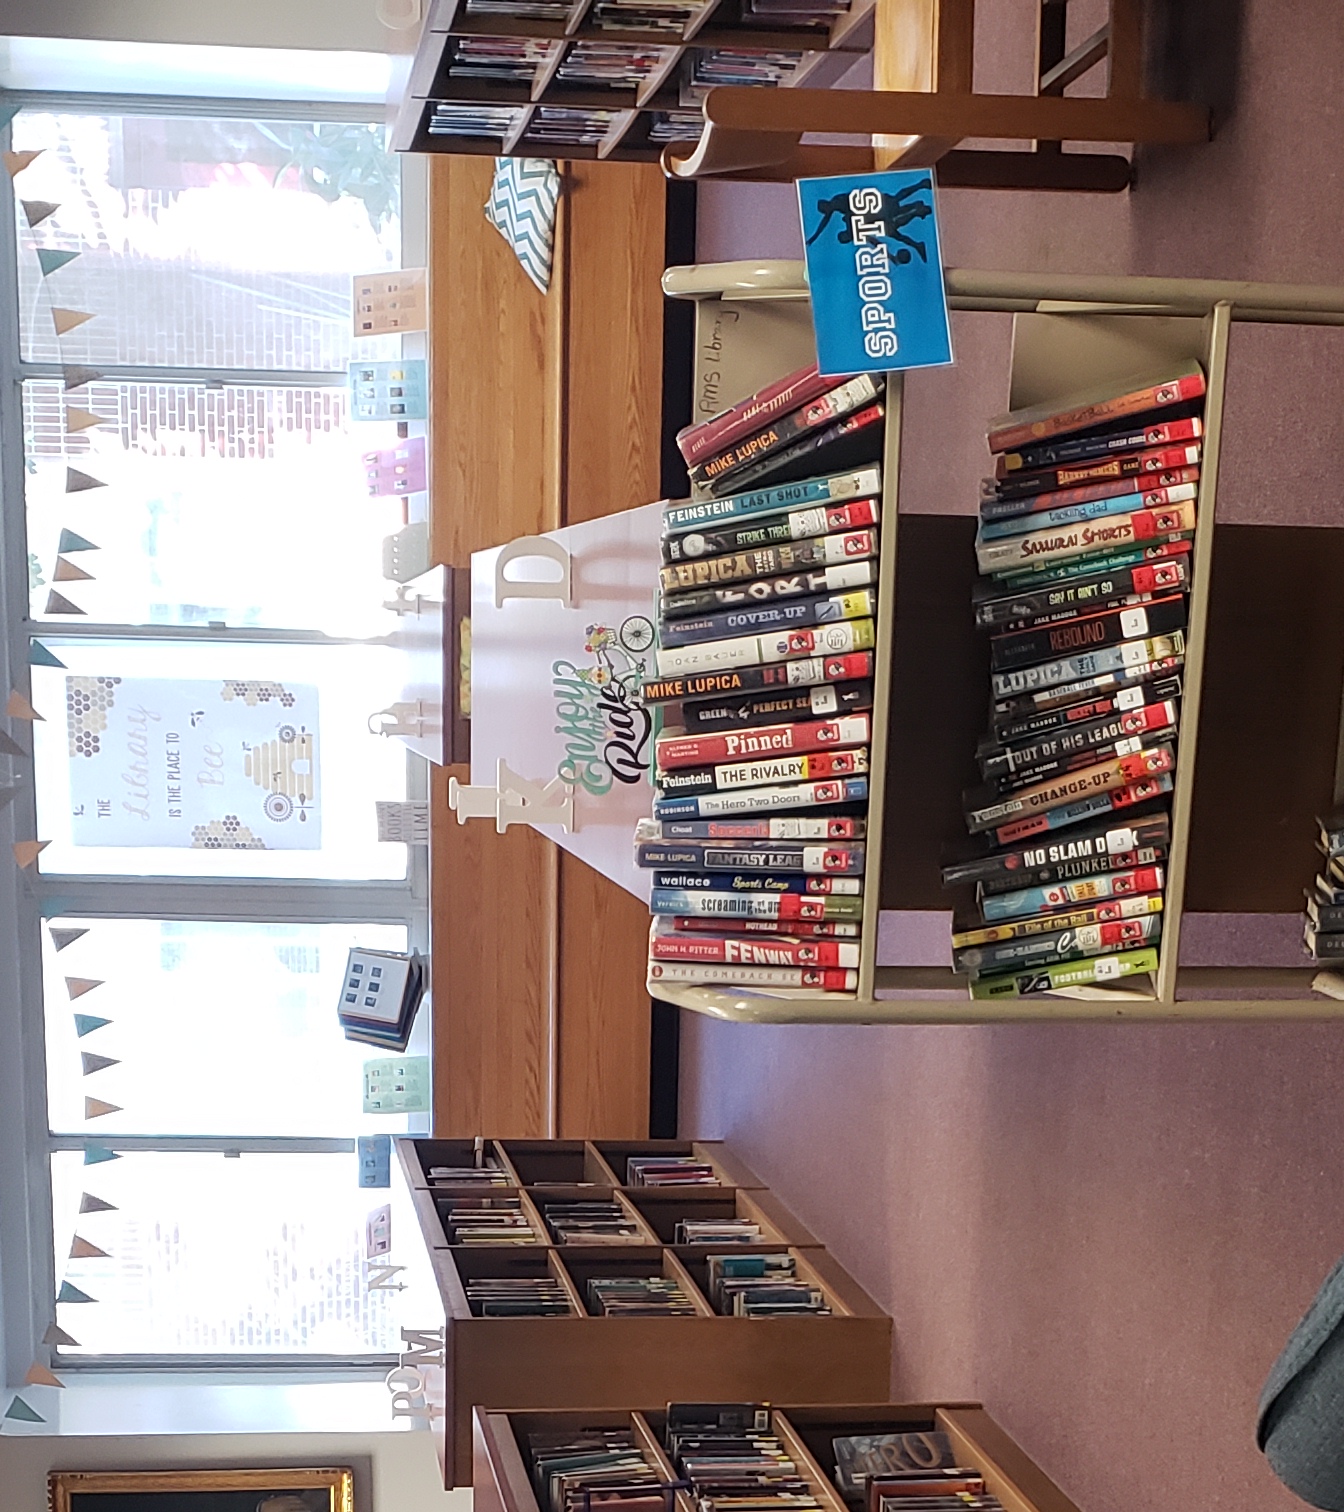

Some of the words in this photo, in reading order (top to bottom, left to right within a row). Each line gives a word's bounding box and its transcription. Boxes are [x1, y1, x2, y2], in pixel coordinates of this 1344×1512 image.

[848, 188, 898, 358] SPORTS
[705, 453, 737, 477] MIKE
[737, 430, 779, 462] LUPICA
[668, 500, 734, 524] FEINSTEIN
[740, 493, 773, 509] LAST
[777, 486, 809, 501] SHOT
[1049, 507, 1086, 523] tackling
[1090, 501, 1108, 514] dad
[736, 531, 766, 545] STRIKE
[1020, 534, 1078, 558] SAMURAI
[1081, 524, 1132, 547] SHORTS
[495, 535, 572, 609] D
[662, 556, 752, 589] LUPICA
[754, 552, 763, 574] THE
[715, 573, 827, 603] FORT
[1048, 592, 1065, 605] SAY
[1067, 590, 1075, 601] IT
[1077, 584, 1098, 599] AIN'T
[1101, 581, 1113, 594] SO
[668, 620, 713, 633] Feinstein
[727, 606, 806, 627] COVER-UP
[1049, 621, 1105, 651] REBOUND
[668, 656, 699, 666] JOAN
[706, 650, 745, 662] BAUER
[1077, 656, 1086, 675] THE
[646, 682, 684, 699] MIKE
[687, 673, 742, 693] LUPICA
[997, 660, 1077, 695] LUPICA
[1048, 684, 1077, 698] BASEBALL
[1078, 679, 1096, 691] FEVER
[699, 709, 729, 721] GREEN
[753, 699, 795, 714] PERFECT
[166, 733, 179, 743] TO
[553, 661, 613, 796] Enjoy
[596, 678, 652, 784] Ride
[725, 729, 794, 756] Pinned
[1014, 747, 1037, 766] OUT
[1042, 742, 1058, 757] OF
[1062, 734, 1084, 749] HIS
[121, 704, 161, 821] Library
[167, 750, 181, 780] PLACE
[197, 742, 224, 787] Bee
[662, 772, 713, 789] Feinstein
[721, 769, 747, 784] THE
[750, 762, 805, 782] RIVALRY
[167, 786, 181, 803] THE
[496, 758, 574, 834] K
[1030, 771, 1112, 806] CHANGE-UP
[97, 799, 111, 818] THE
[169, 809, 181, 818] IS
[659, 805, 696, 815] ROBINSON
[706, 802, 720, 810] The
[721, 797, 746, 810] Hero
[748, 797, 770, 806] Two
[772, 793, 801, 805] Doors
[387, 802, 403, 842] BOOKS
[645, 852, 666, 862] MIKE
[667, 853, 697, 863] LUPICA
[708, 852, 765, 866] FANTASY
[1024, 851, 1046, 868] NO
[1049, 837, 1092, 863] SLAM
[660, 875, 711, 887] wallace
[732, 876, 763, 890] Sports
[764, 878, 789, 892] Camp
[701, 897, 754, 916] screaming
[745, 922, 778, 931] HOTHEAD
[1054, 917, 1068, 927] the
[657, 944, 679, 954] JOHN
[689, 945, 718, 955] RITTER
[725, 940, 794, 965] FENWAY
[671, 968, 696, 977] THE
[704, 970, 773, 980] COMEBACK
[367, 1261, 407, 1292] N
[400, 1326, 444, 1369] M
[392, 1391, 434, 1420] P
